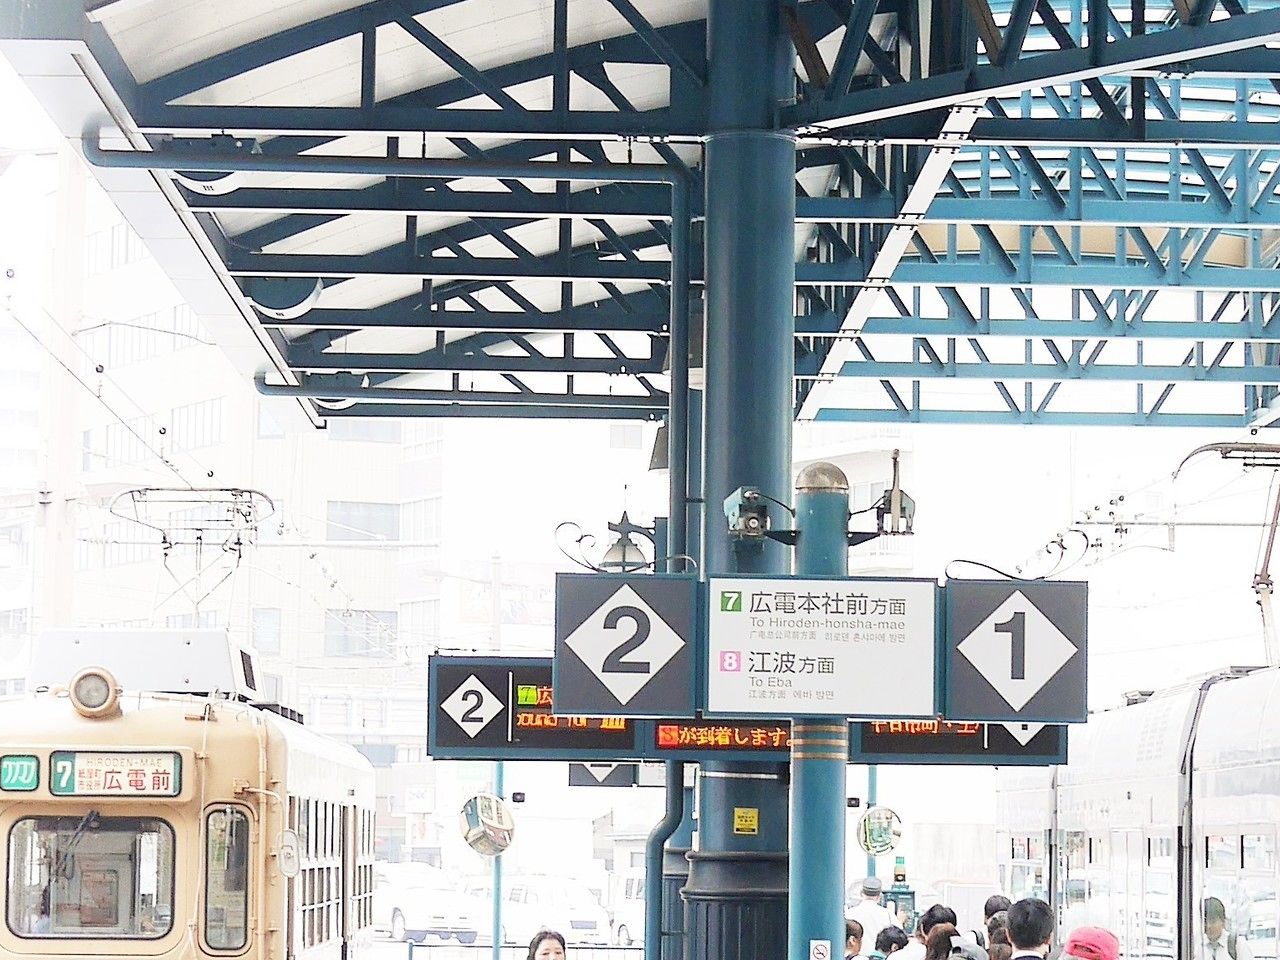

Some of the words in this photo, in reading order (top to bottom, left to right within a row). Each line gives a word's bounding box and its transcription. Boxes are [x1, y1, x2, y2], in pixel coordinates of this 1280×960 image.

[723, 592, 740, 611] 7
[749, 591, 907, 616] 広電本社前方面
[751, 617, 765, 628] To
[769, 617, 906, 630] Hiroden-honsha-mae
[601, 605, 652, 674] 2
[993, 611, 1027, 680] 1
[722, 652, 739, 671] 8
[748, 651, 835, 675] 江波方面
[749, 677, 764, 688] To
[767, 677, 793, 688] Eba
[460, 689, 484, 723] 2
[56, 760, 72, 788] 7
[102, 768, 171, 791] 広電前
